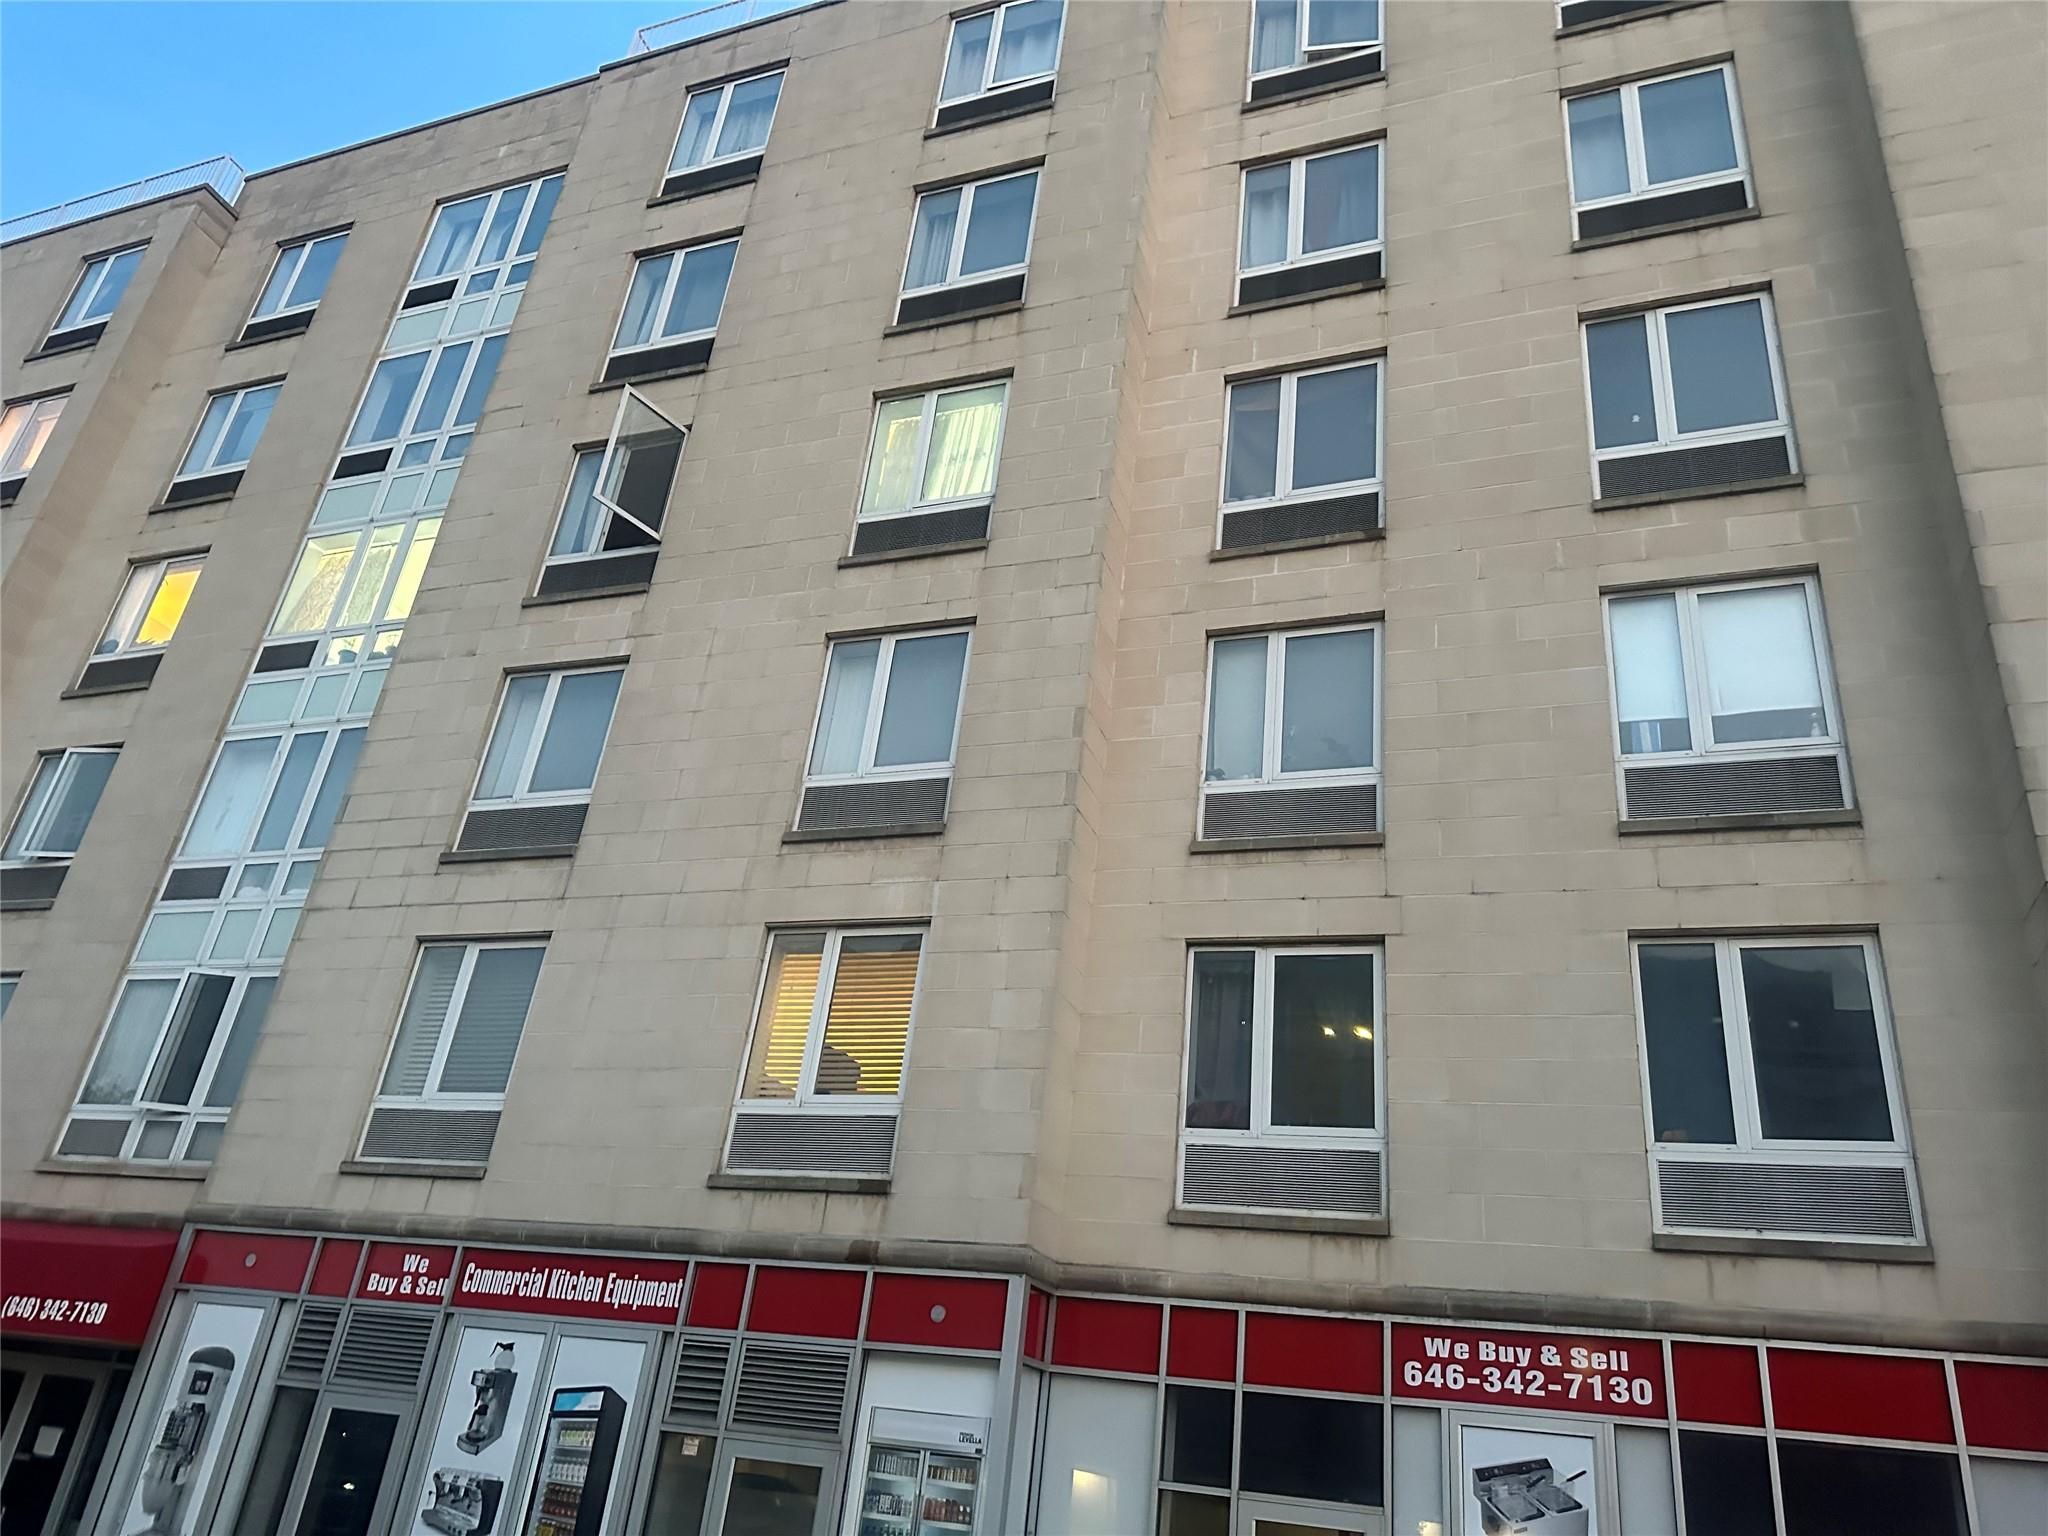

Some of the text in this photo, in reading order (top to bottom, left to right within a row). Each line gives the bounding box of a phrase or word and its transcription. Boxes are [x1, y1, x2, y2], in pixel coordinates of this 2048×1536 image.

[403, 1254, 430, 1274] We
[366, 1273, 450, 1297] Buy & Sell
[461, 1262, 684, 1310] Commercial Kitchen Equipment
[1, 1295, 108, 1325] (646) 342-7130
[1424, 1337, 1629, 1372] We Buy & Sell
[1404, 1361, 1653, 1406] 646-342-7130
